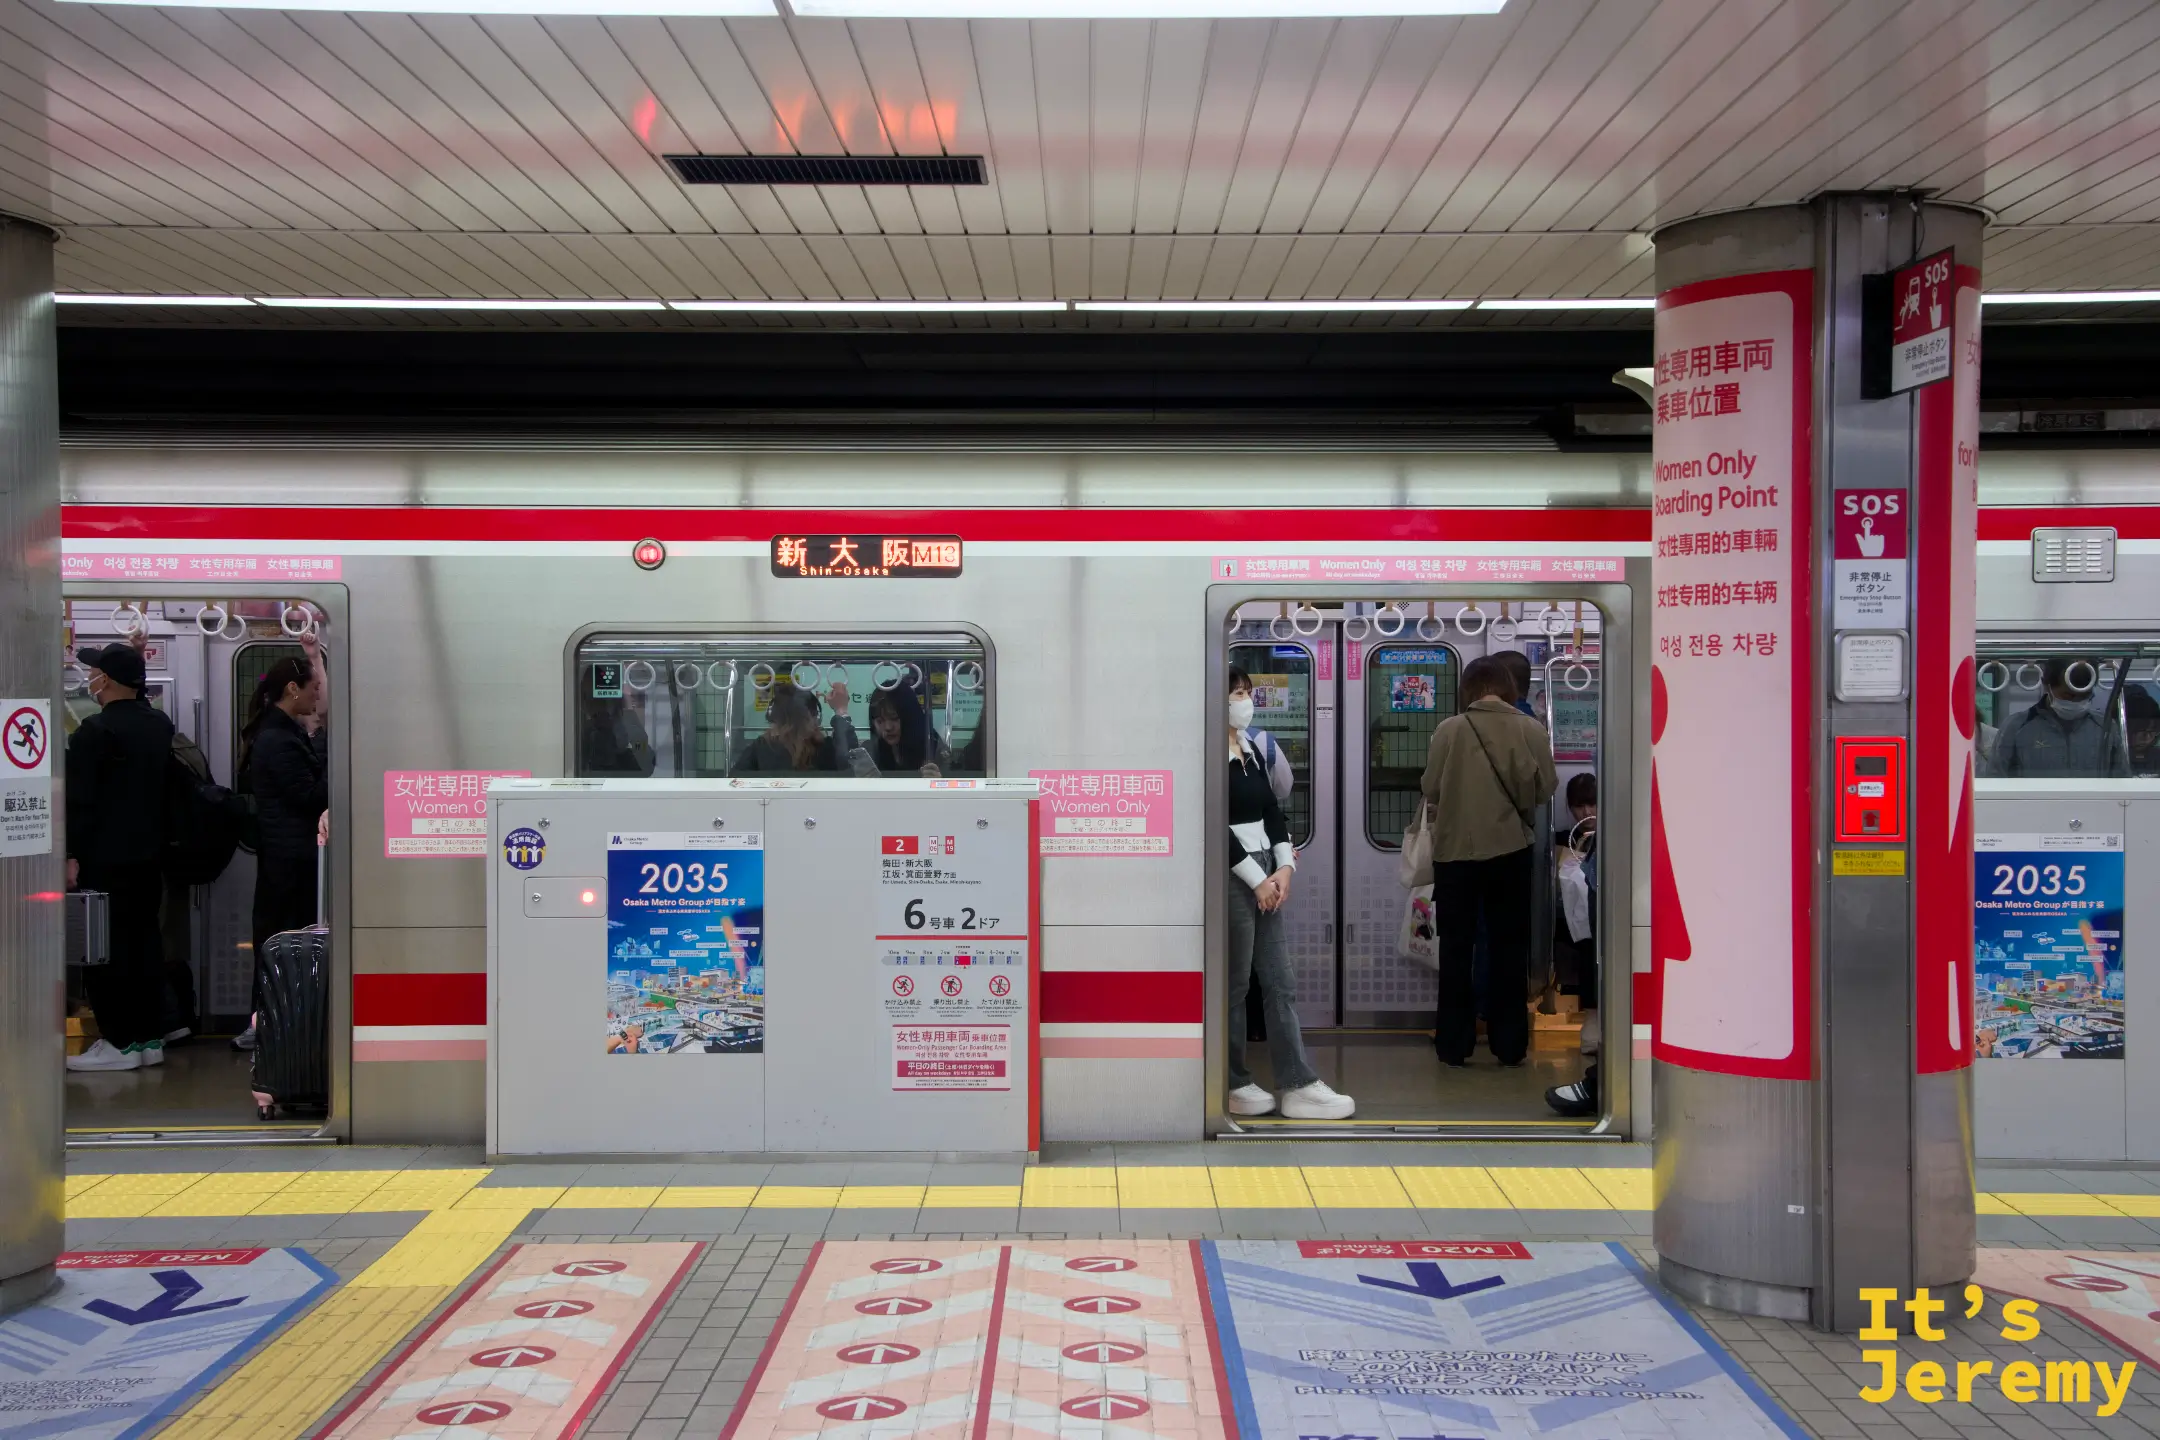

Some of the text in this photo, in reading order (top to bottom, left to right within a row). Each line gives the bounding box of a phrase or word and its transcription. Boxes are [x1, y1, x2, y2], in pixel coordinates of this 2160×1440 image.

[1924, 259, 1948, 288] SOS
[1654, 338, 1775, 387] 性専用車両
[1657, 382, 1741, 425] 乗車位置
[1655, 449, 1757, 483] Women Only
[1719, 485, 1778, 509] Point
[1843, 494, 1900, 516] SOS
[777, 538, 956, 567] 新大阪 M13
[67, 558, 93, 571] Only
[103, 557, 180, 570] 여성 전용 차량
[1320, 559, 1386, 571] Women Only
[1395, 559, 1467, 571] 여성 전용 차량
[800, 566, 889, 576] Shin-Osaka
[1849, 572, 1892, 582] 非常停止
[1657, 581, 1778, 608] 女性专用的车辆
[1856, 584, 1886, 593] ボタン
[1660, 632, 1777, 658] 여성 전용 차량
[1038, 774, 1164, 797] 女性専用車両
[5, 796, 47, 812] 駆込禁止
[407, 800, 468, 814] Women
[1050, 799, 1150, 815] Women Only
[895, 839, 905, 852] 2
[882, 859, 932, 867] 梅田・新大阪
[639, 862, 729, 893] 2035
[1992, 864, 2086, 895] 2035
[622, 898, 649, 906] Osaka
[651, 898, 677, 906] Metro
[1975, 900, 2002, 908] Osaka
[2005, 900, 2032, 908] Metro
[897, 1031, 1007, 1042] 女性専用車両 乗車位置
[1421, 1245, 1495, 1254] M20
[160, 1253, 232, 1262] M20
[1299, 1349, 1653, 1362] 降車する方のために
[1328, 1362, 1640, 1374] この付近をあけて
[1348, 1374, 1645, 1388] お待ちください。
[1296, 1386, 1704, 1400] Please leave this area open.
